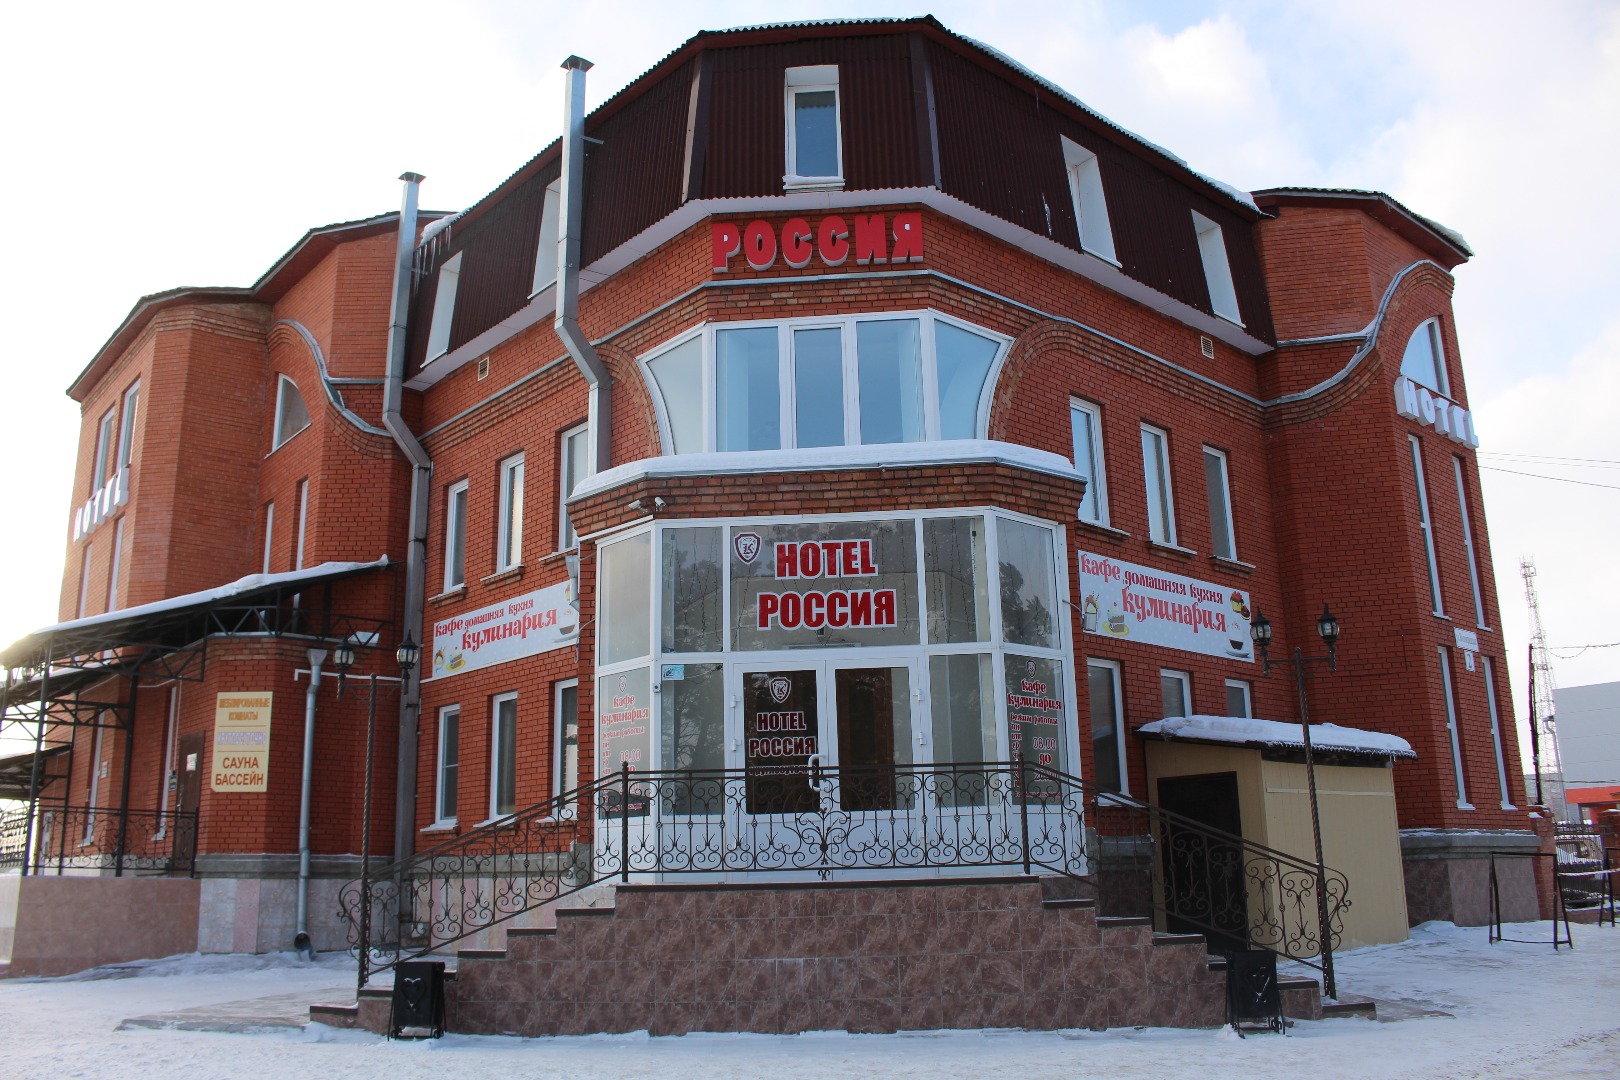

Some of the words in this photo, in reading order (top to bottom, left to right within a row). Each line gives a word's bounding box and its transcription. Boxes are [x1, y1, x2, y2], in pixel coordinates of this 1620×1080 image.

[711, 212, 924, 273] РОССИЯ
[1394, 375, 1479, 449] HOTEL
[775, 540, 878, 580] HOTEL
[1123, 570, 1186, 594] домашняя
[1189, 582, 1223, 605] кухня
[464, 608, 504, 630] домашняя
[508, 599, 534, 616] кухня
[757, 589, 897, 631] РОССИЯ
[757, 711, 807, 731] HOTEL
[222, 756, 259, 770] САУНА
[749, 736, 816, 757] РОССИЯ
[215, 771, 264, 786] БАССЕЙН
